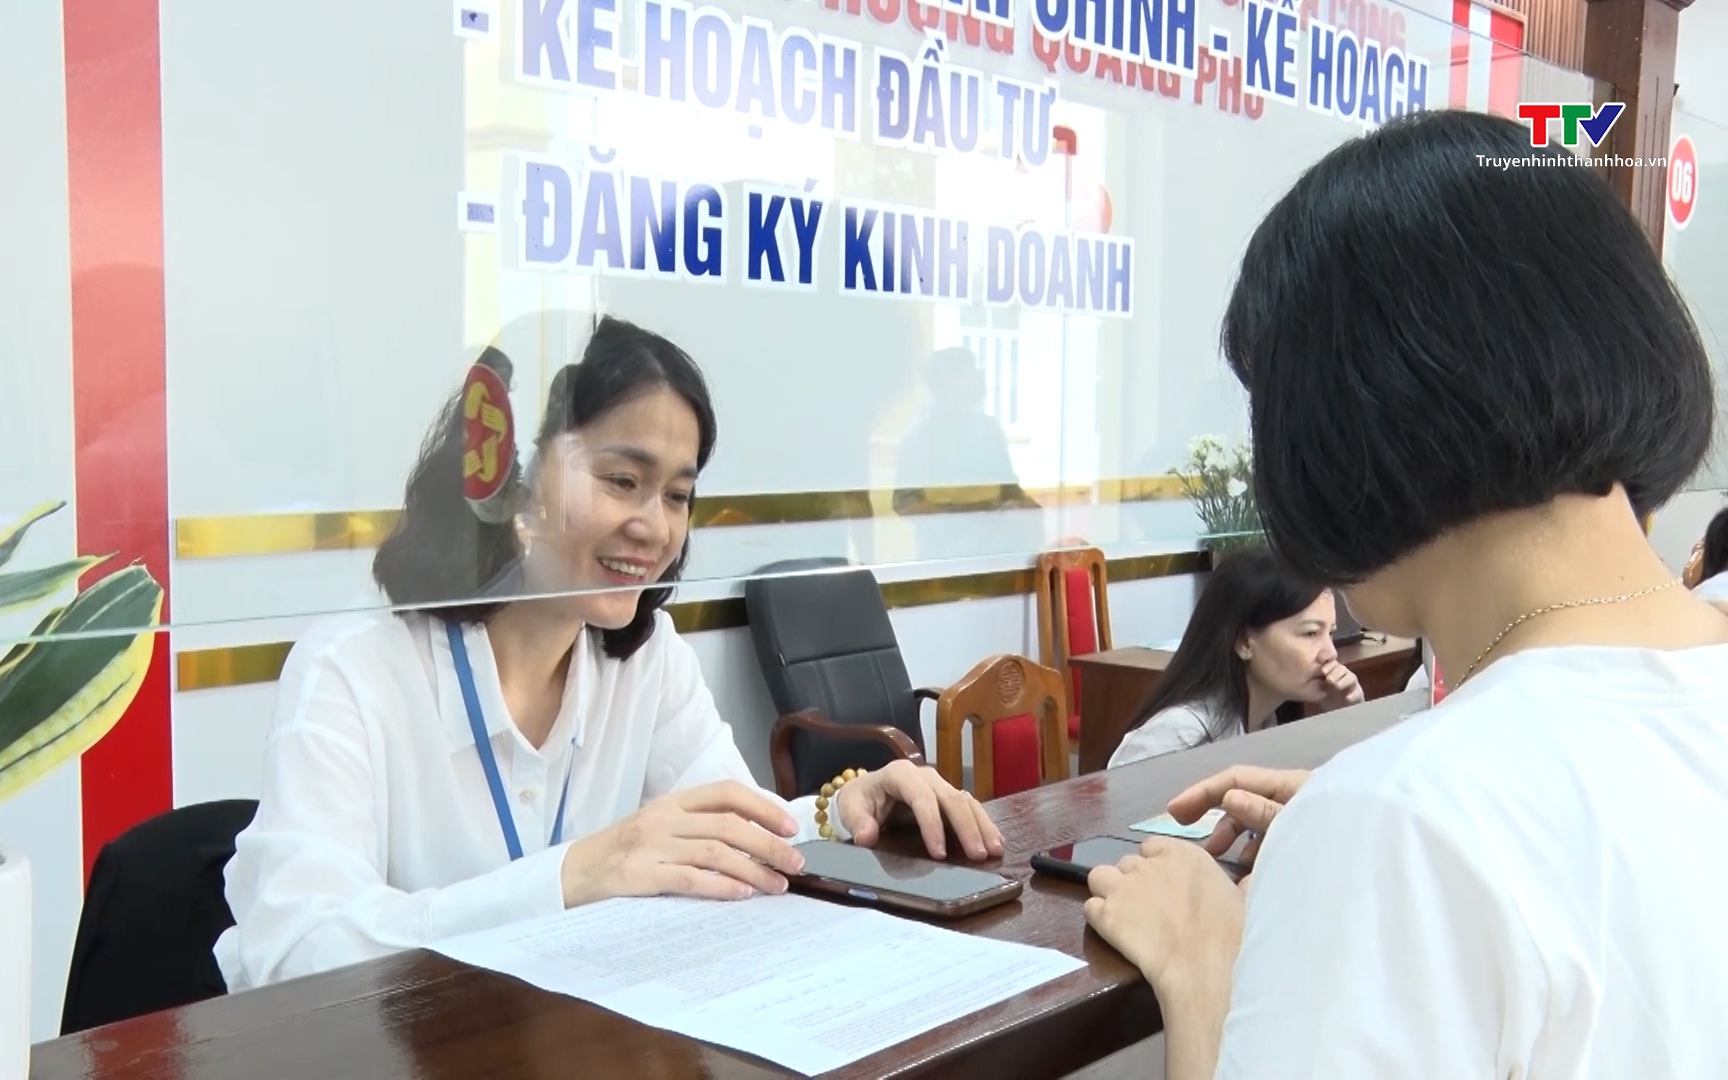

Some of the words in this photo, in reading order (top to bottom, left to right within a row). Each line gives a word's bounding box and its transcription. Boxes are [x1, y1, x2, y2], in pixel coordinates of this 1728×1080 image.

[645, 1, 856, 139] HOẠCH
[877, 38, 979, 152] ĐẦU
[997, 81, 1057, 166] TƯ
[522, 145, 722, 276] ĐĂNG
[748, 178, 823, 283] KÝ
[845, 206, 968, 298] KINH
[987, 225, 1131, 312] DOANH
[1672, 158, 1693, 203] 06
